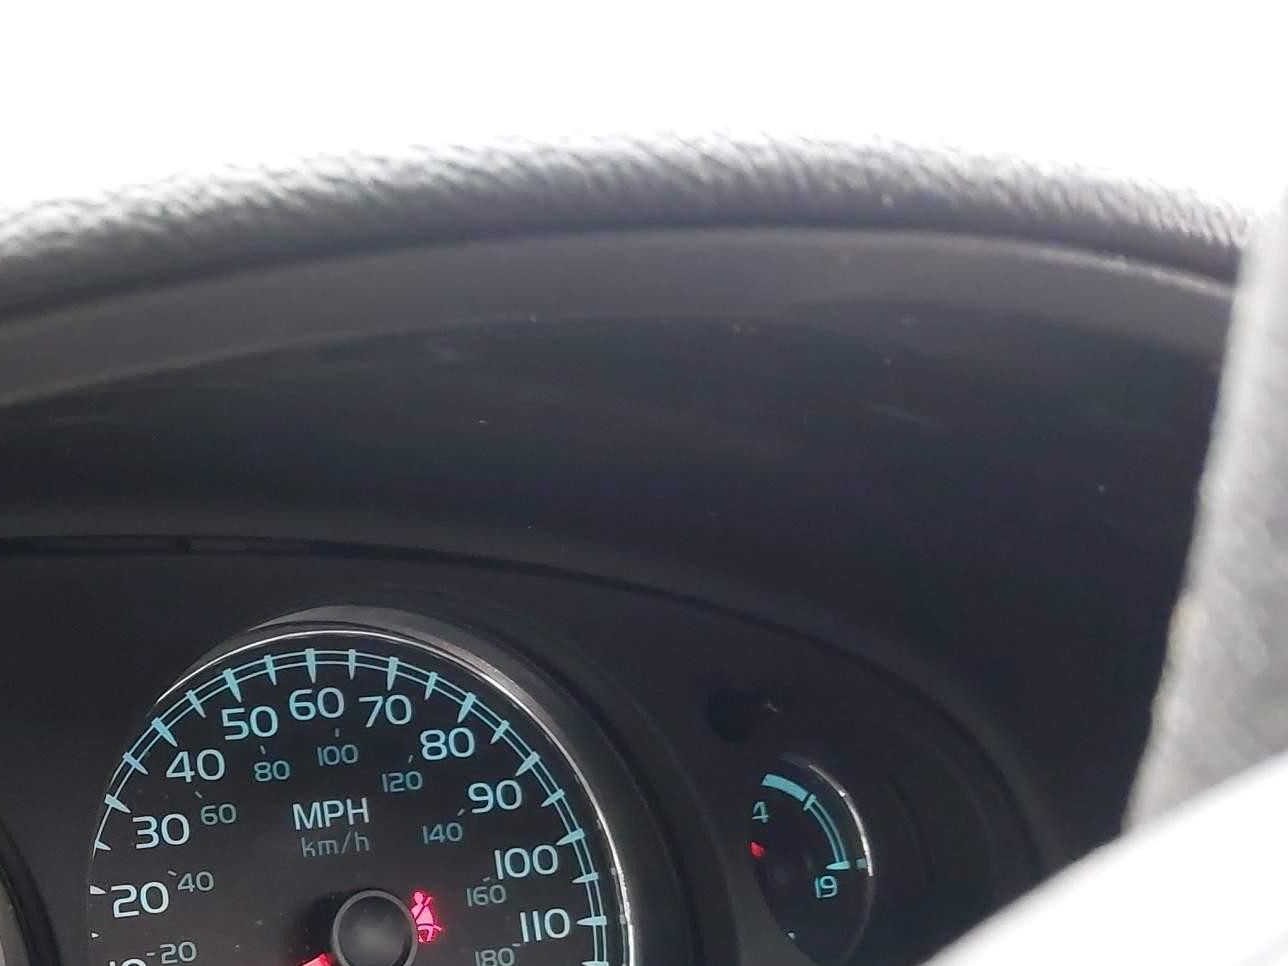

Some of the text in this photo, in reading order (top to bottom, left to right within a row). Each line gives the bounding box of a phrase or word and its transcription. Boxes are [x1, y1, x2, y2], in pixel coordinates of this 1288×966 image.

[289, 687, 344, 720] 60
[359, 695, 412, 728] 70
[221, 706, 278, 740] 50
[317, 745, 358, 766] 100
[419, 727, 475, 760] 80
[166, 749, 225, 783] 40
[254, 761, 290, 782] 80
[382, 771, 423, 792] 120
[468, 780, 522, 813] 90
[200, 804, 236, 825] 60
[292, 797, 370, 830] MPH
[132, 813, 190, 849] 30
[300, 831, 370, 857] km/h
[423, 823, 463, 844] 140
[494, 845, 558, 880] 100
[177, 871, 214, 892] 40
[466, 884, 506, 907] 160
[815, 876, 838, 898] 19
[111, 881, 169, 918] 20
[520, 908, 570, 942] 110
[160, 941, 196, 964] 20
